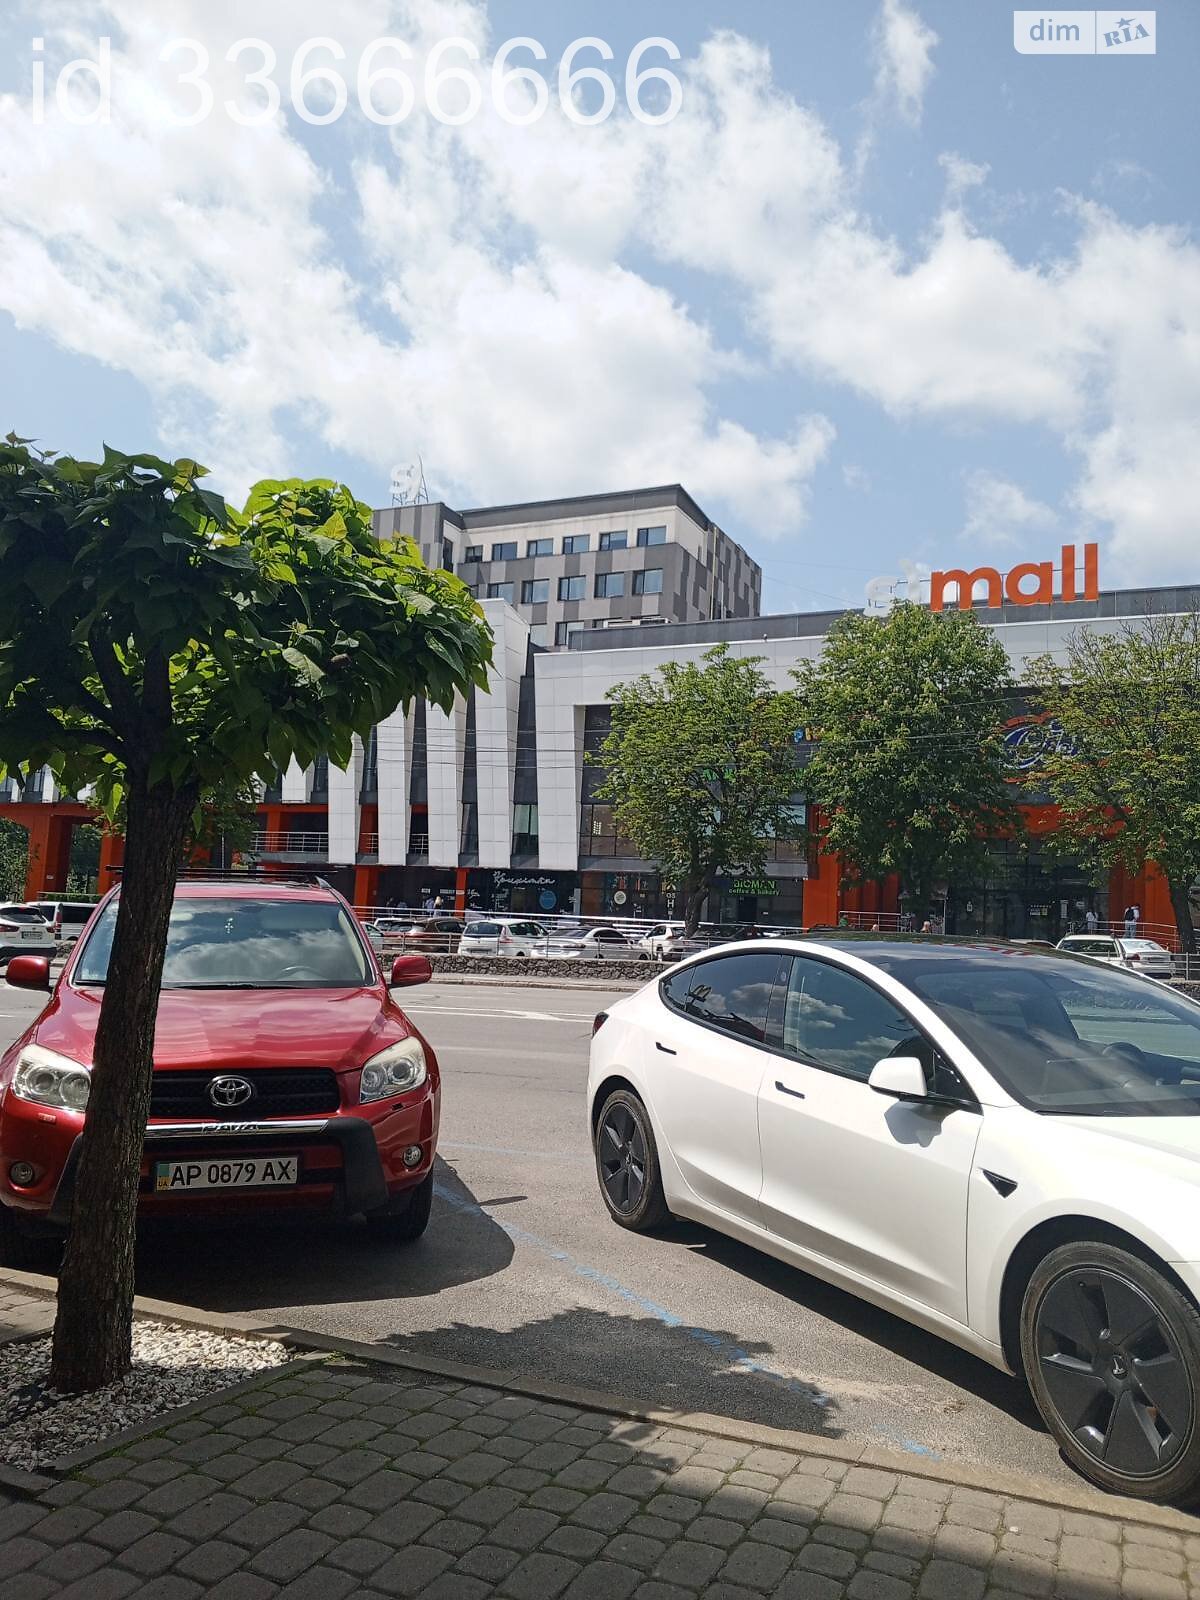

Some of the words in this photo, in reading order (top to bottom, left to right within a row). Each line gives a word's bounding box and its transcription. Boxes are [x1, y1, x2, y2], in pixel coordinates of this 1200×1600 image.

[930, 542, 1099, 612] mall
[170, 1165, 202, 1187] AP
[207, 1162, 257, 1184] 0879
[262, 1161, 292, 1182] AX
